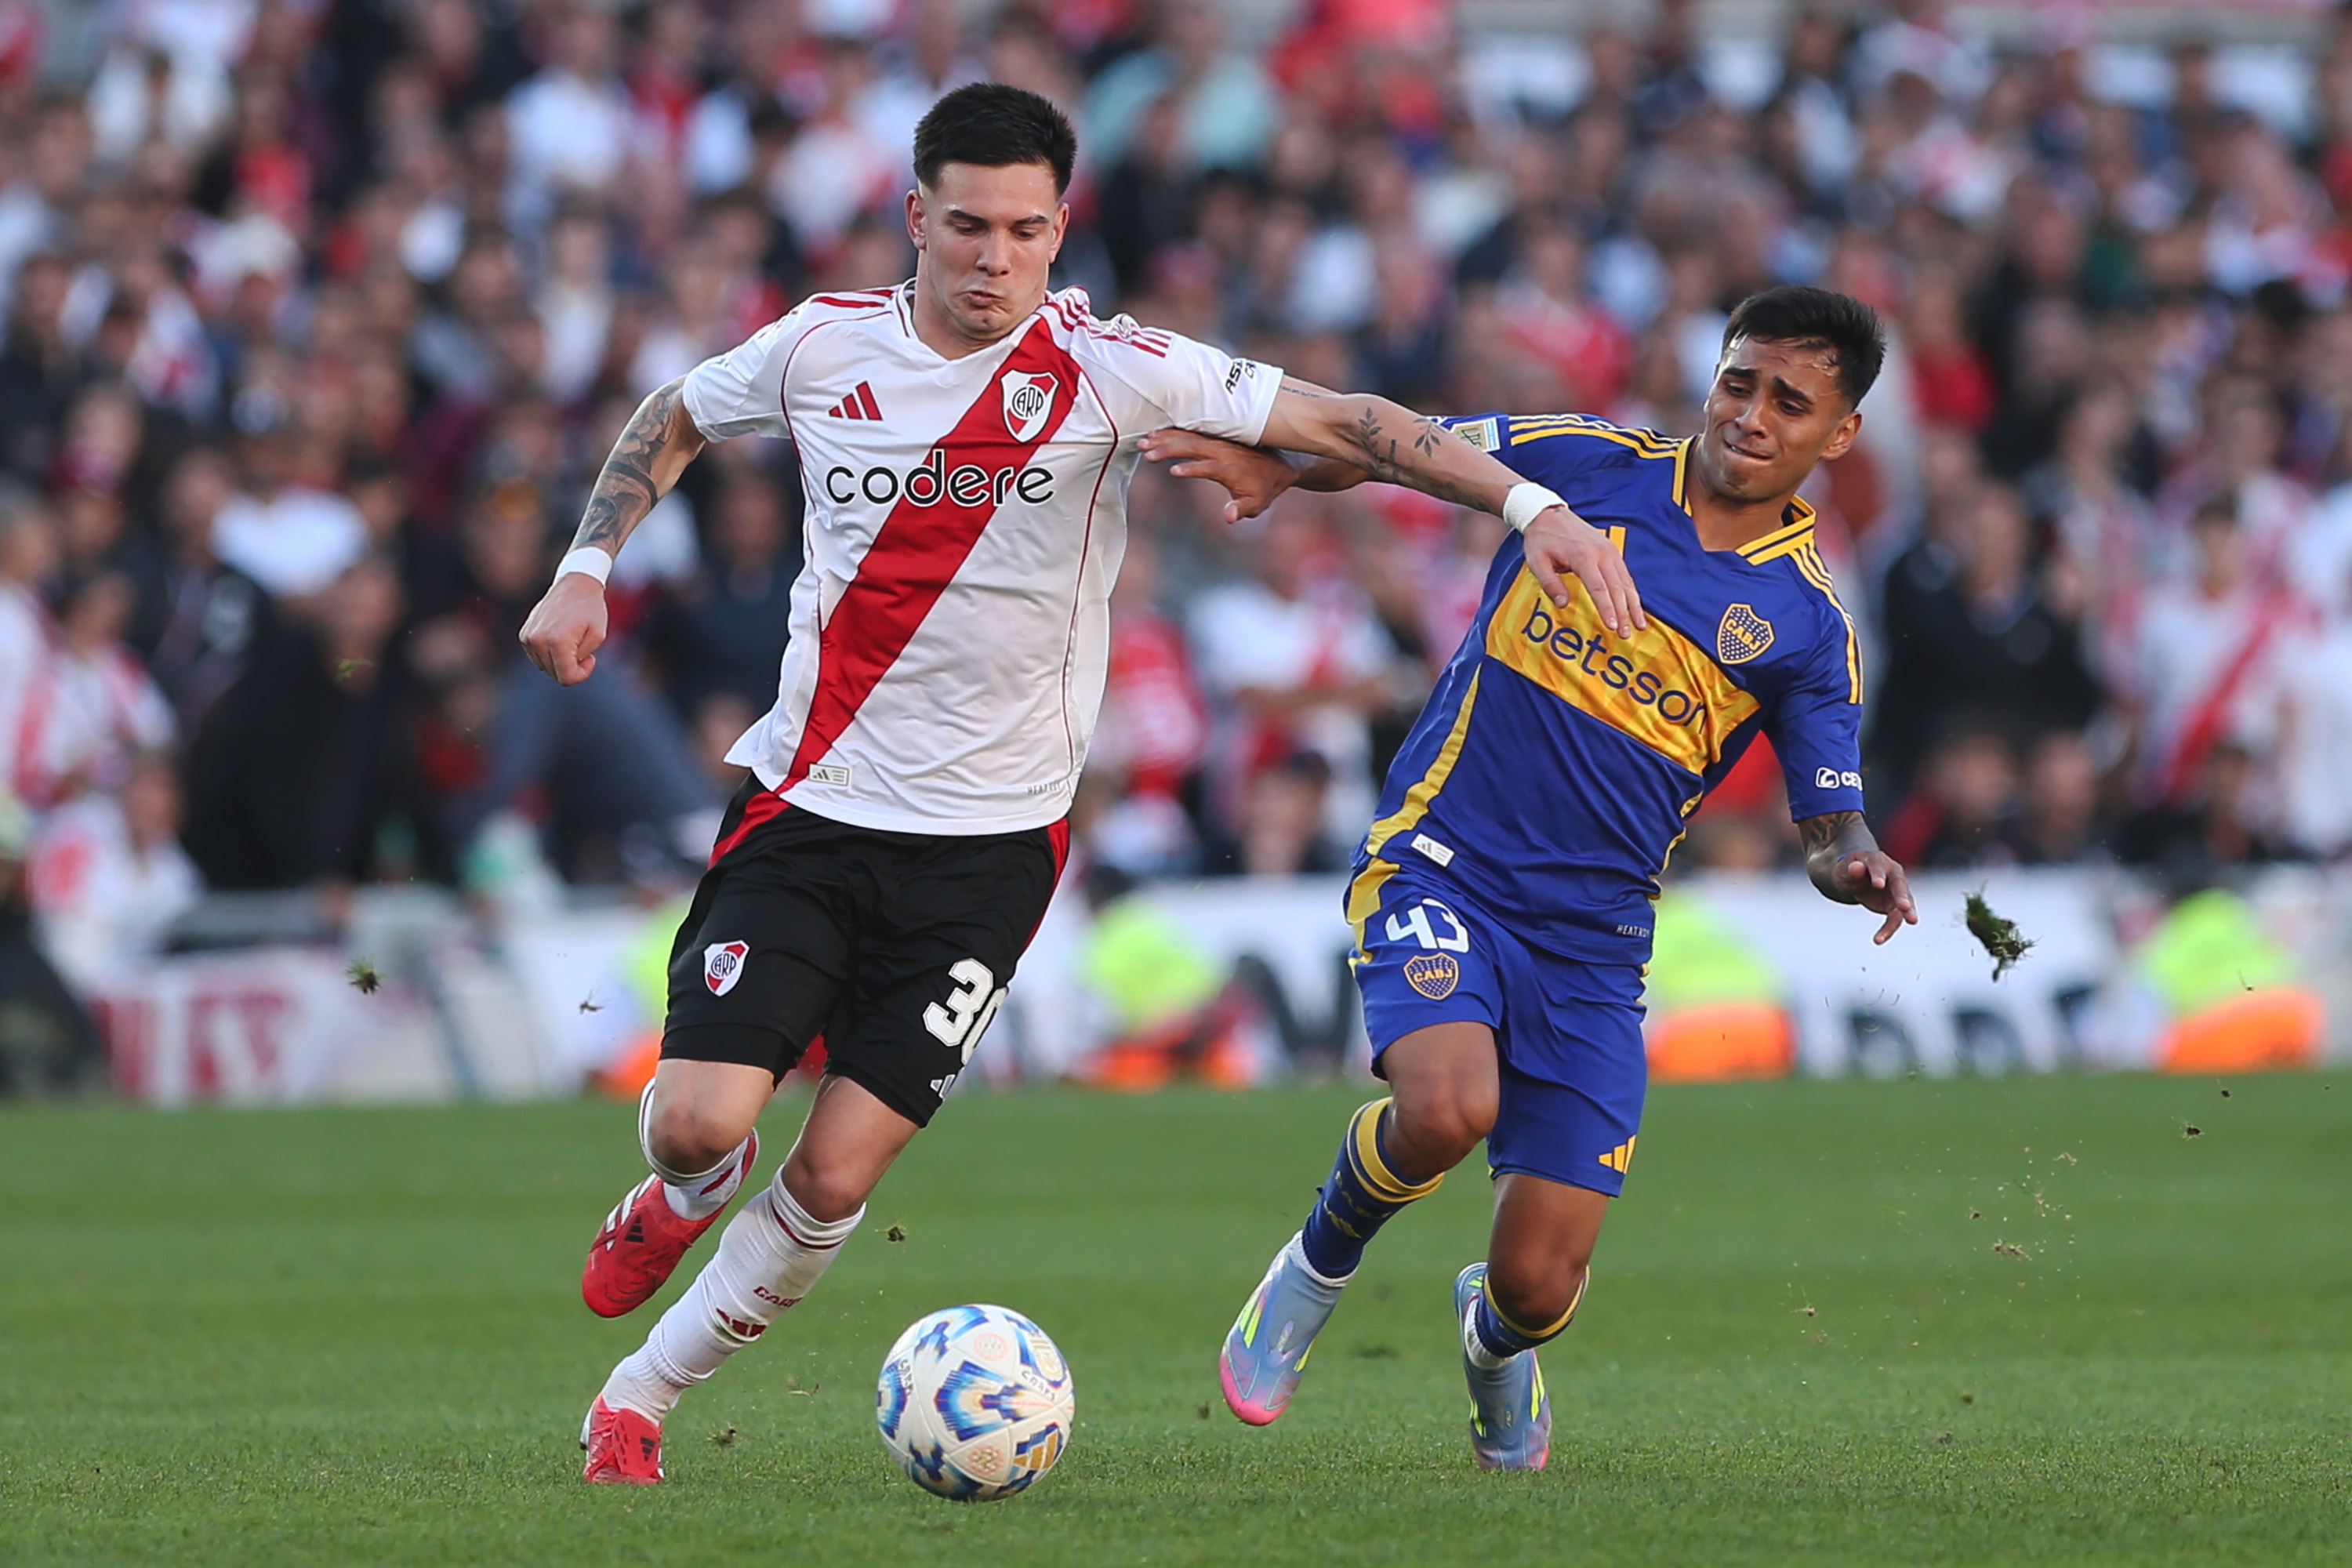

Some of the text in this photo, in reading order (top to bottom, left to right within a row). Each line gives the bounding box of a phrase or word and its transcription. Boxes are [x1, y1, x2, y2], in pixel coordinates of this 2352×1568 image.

[826, 450, 1054, 506] codere
[1725, 619, 1762, 651] CABJ
[1521, 597, 1708, 735] betsson
[1385, 898, 1469, 953] 43
[1413, 968, 1454, 983] CABJ
[753, 1285, 804, 1308] CAR
